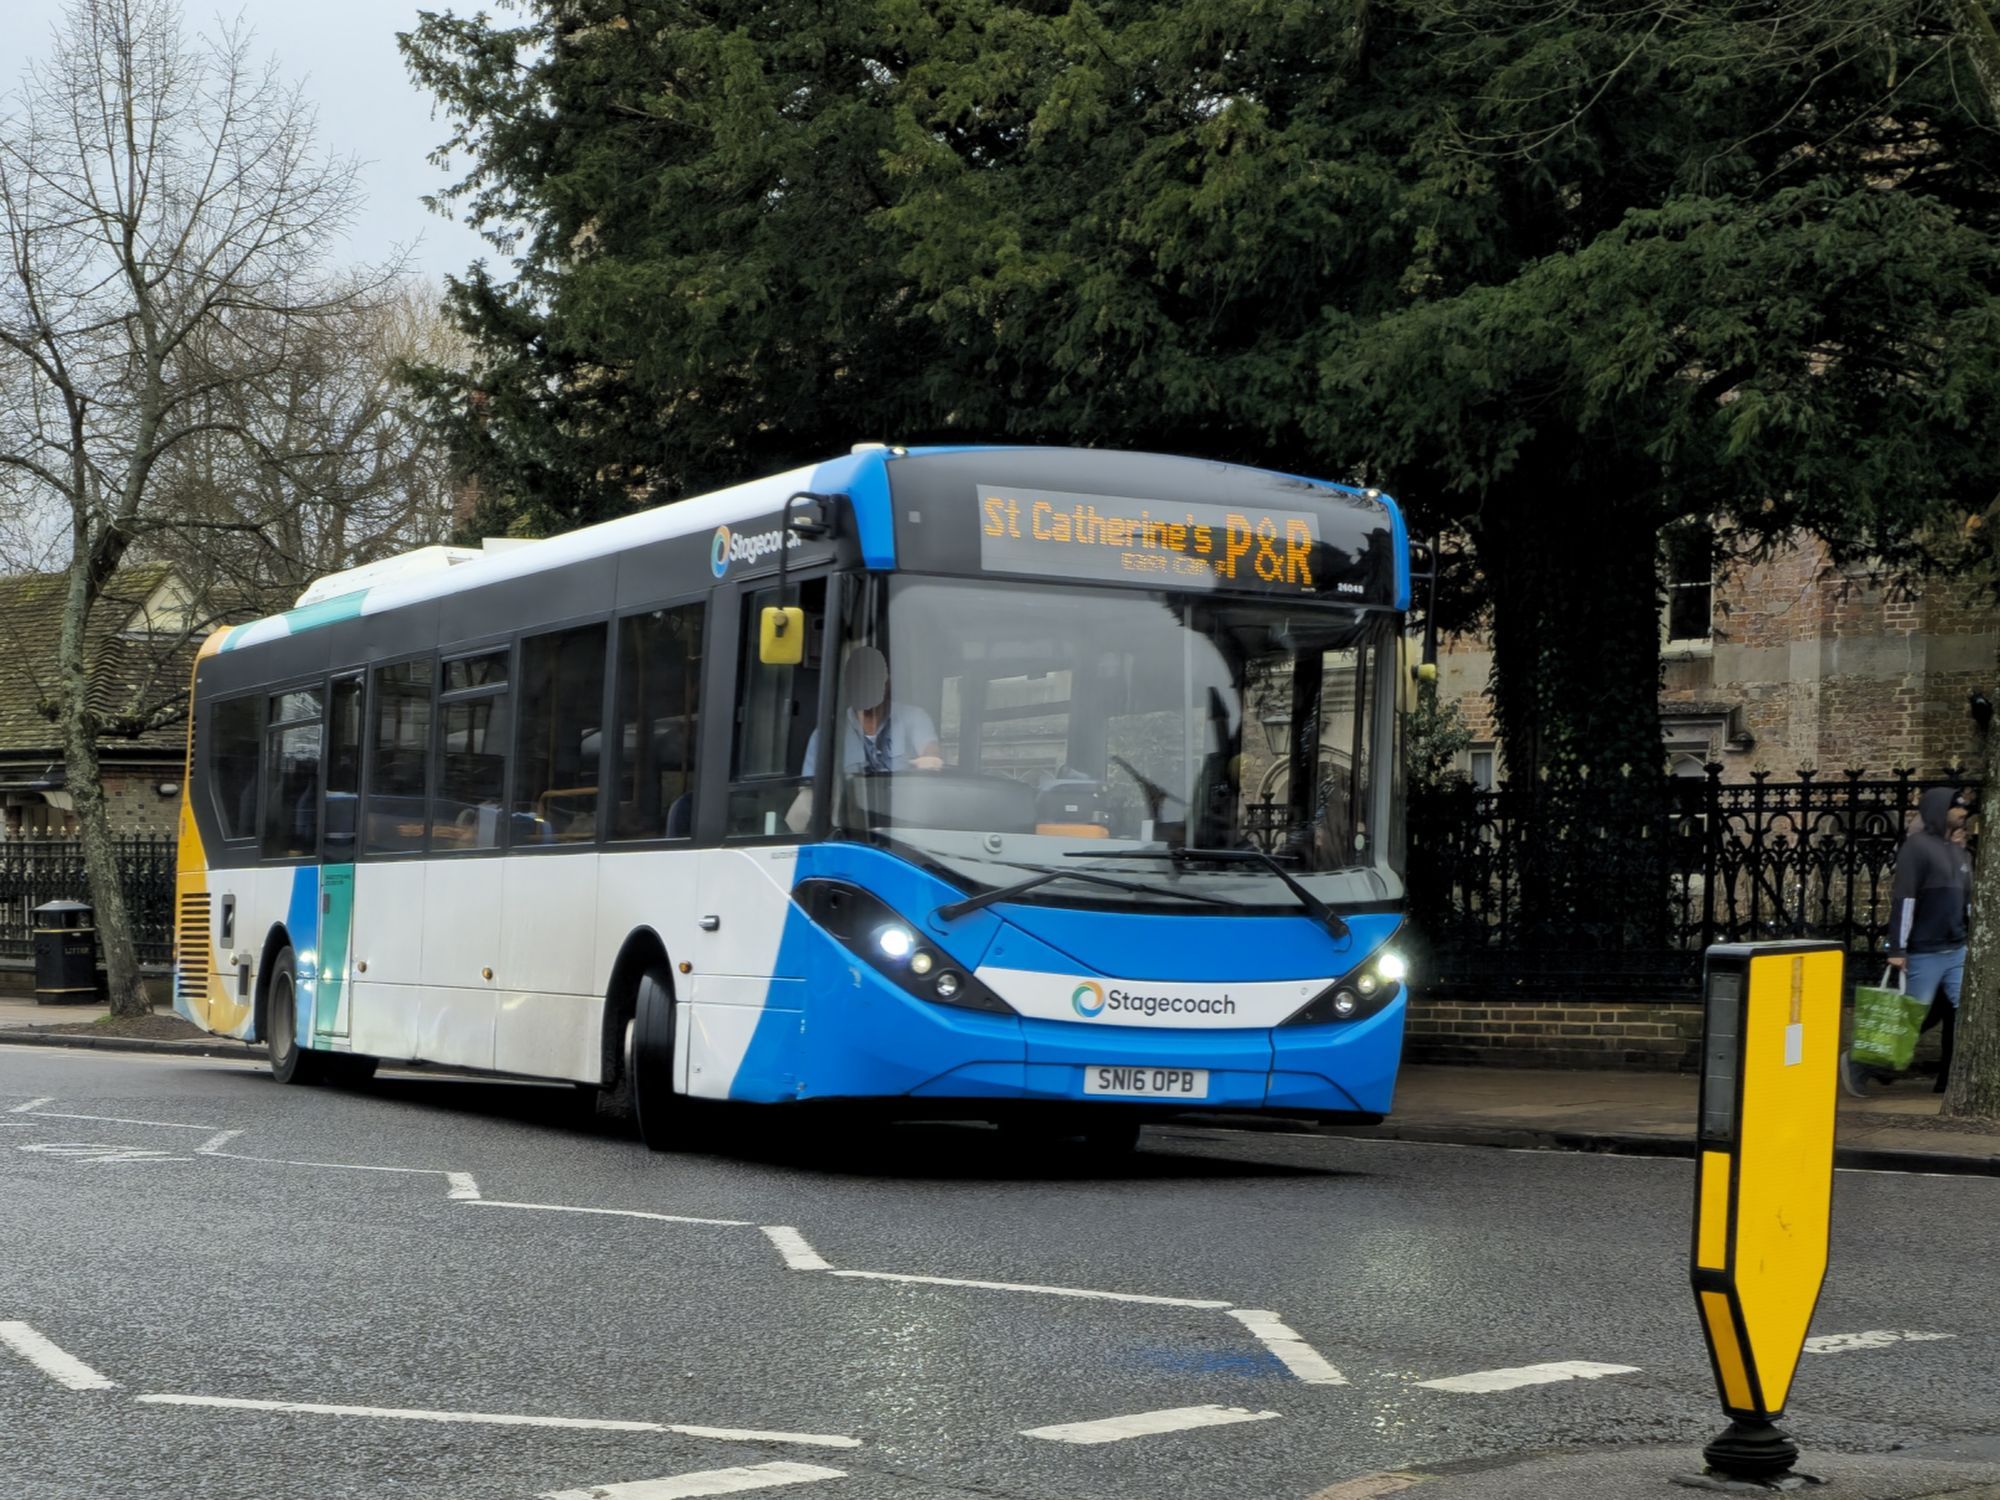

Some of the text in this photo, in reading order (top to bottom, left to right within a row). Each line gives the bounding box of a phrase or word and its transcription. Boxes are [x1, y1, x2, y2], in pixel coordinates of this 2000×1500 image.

[729, 529, 801, 564] Stageco
[983, 497, 1313, 585] St Catherine's P&R
[1107, 989, 1236, 1017] Stagecoach
[1098, 1068, 1194, 1093] SN16 OPB
